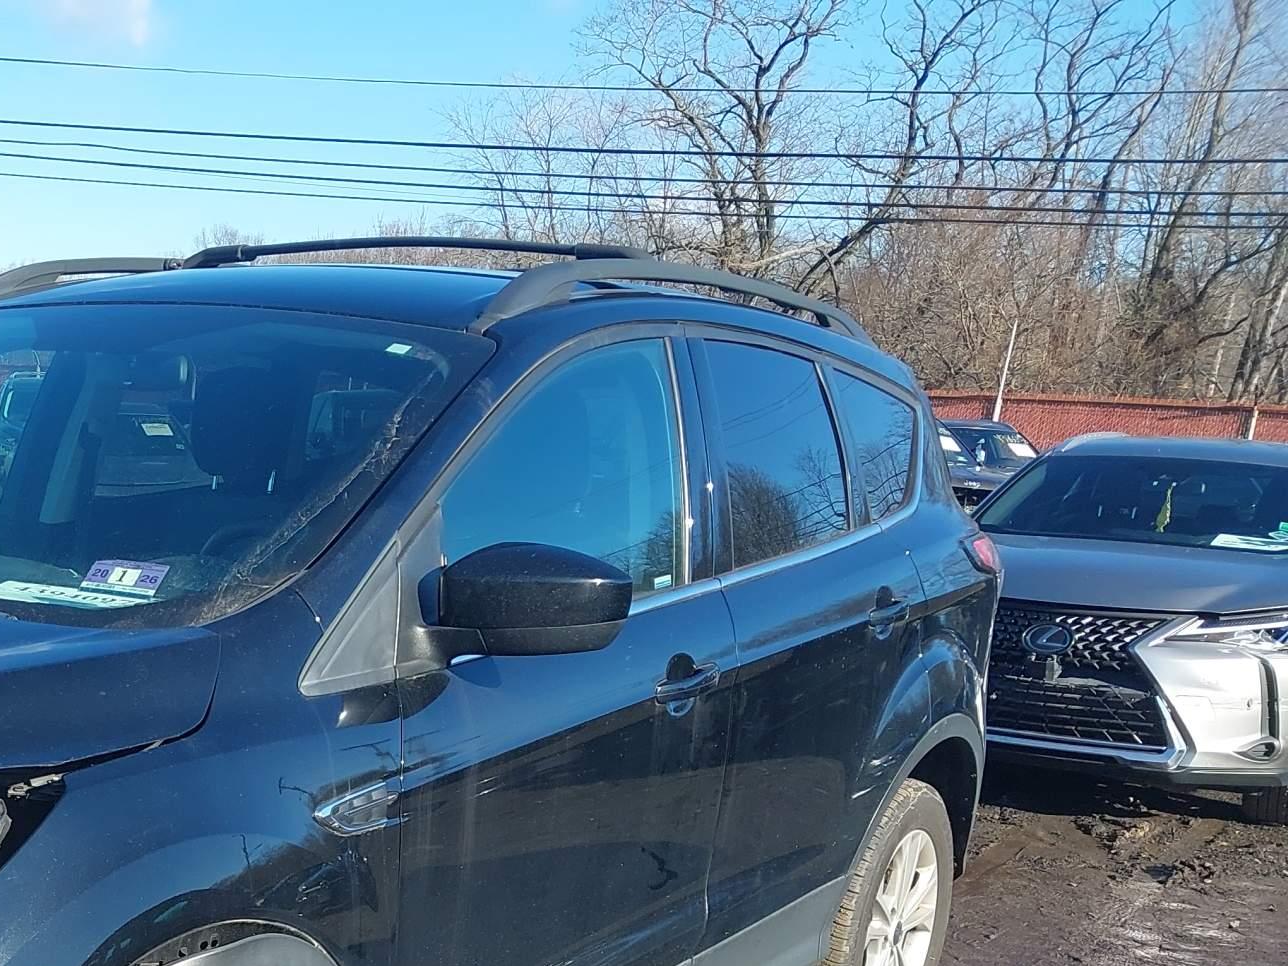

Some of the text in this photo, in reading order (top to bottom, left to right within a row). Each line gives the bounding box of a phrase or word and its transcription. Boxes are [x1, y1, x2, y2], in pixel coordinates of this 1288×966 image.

[91, 568, 160, 584] 20 1 26
